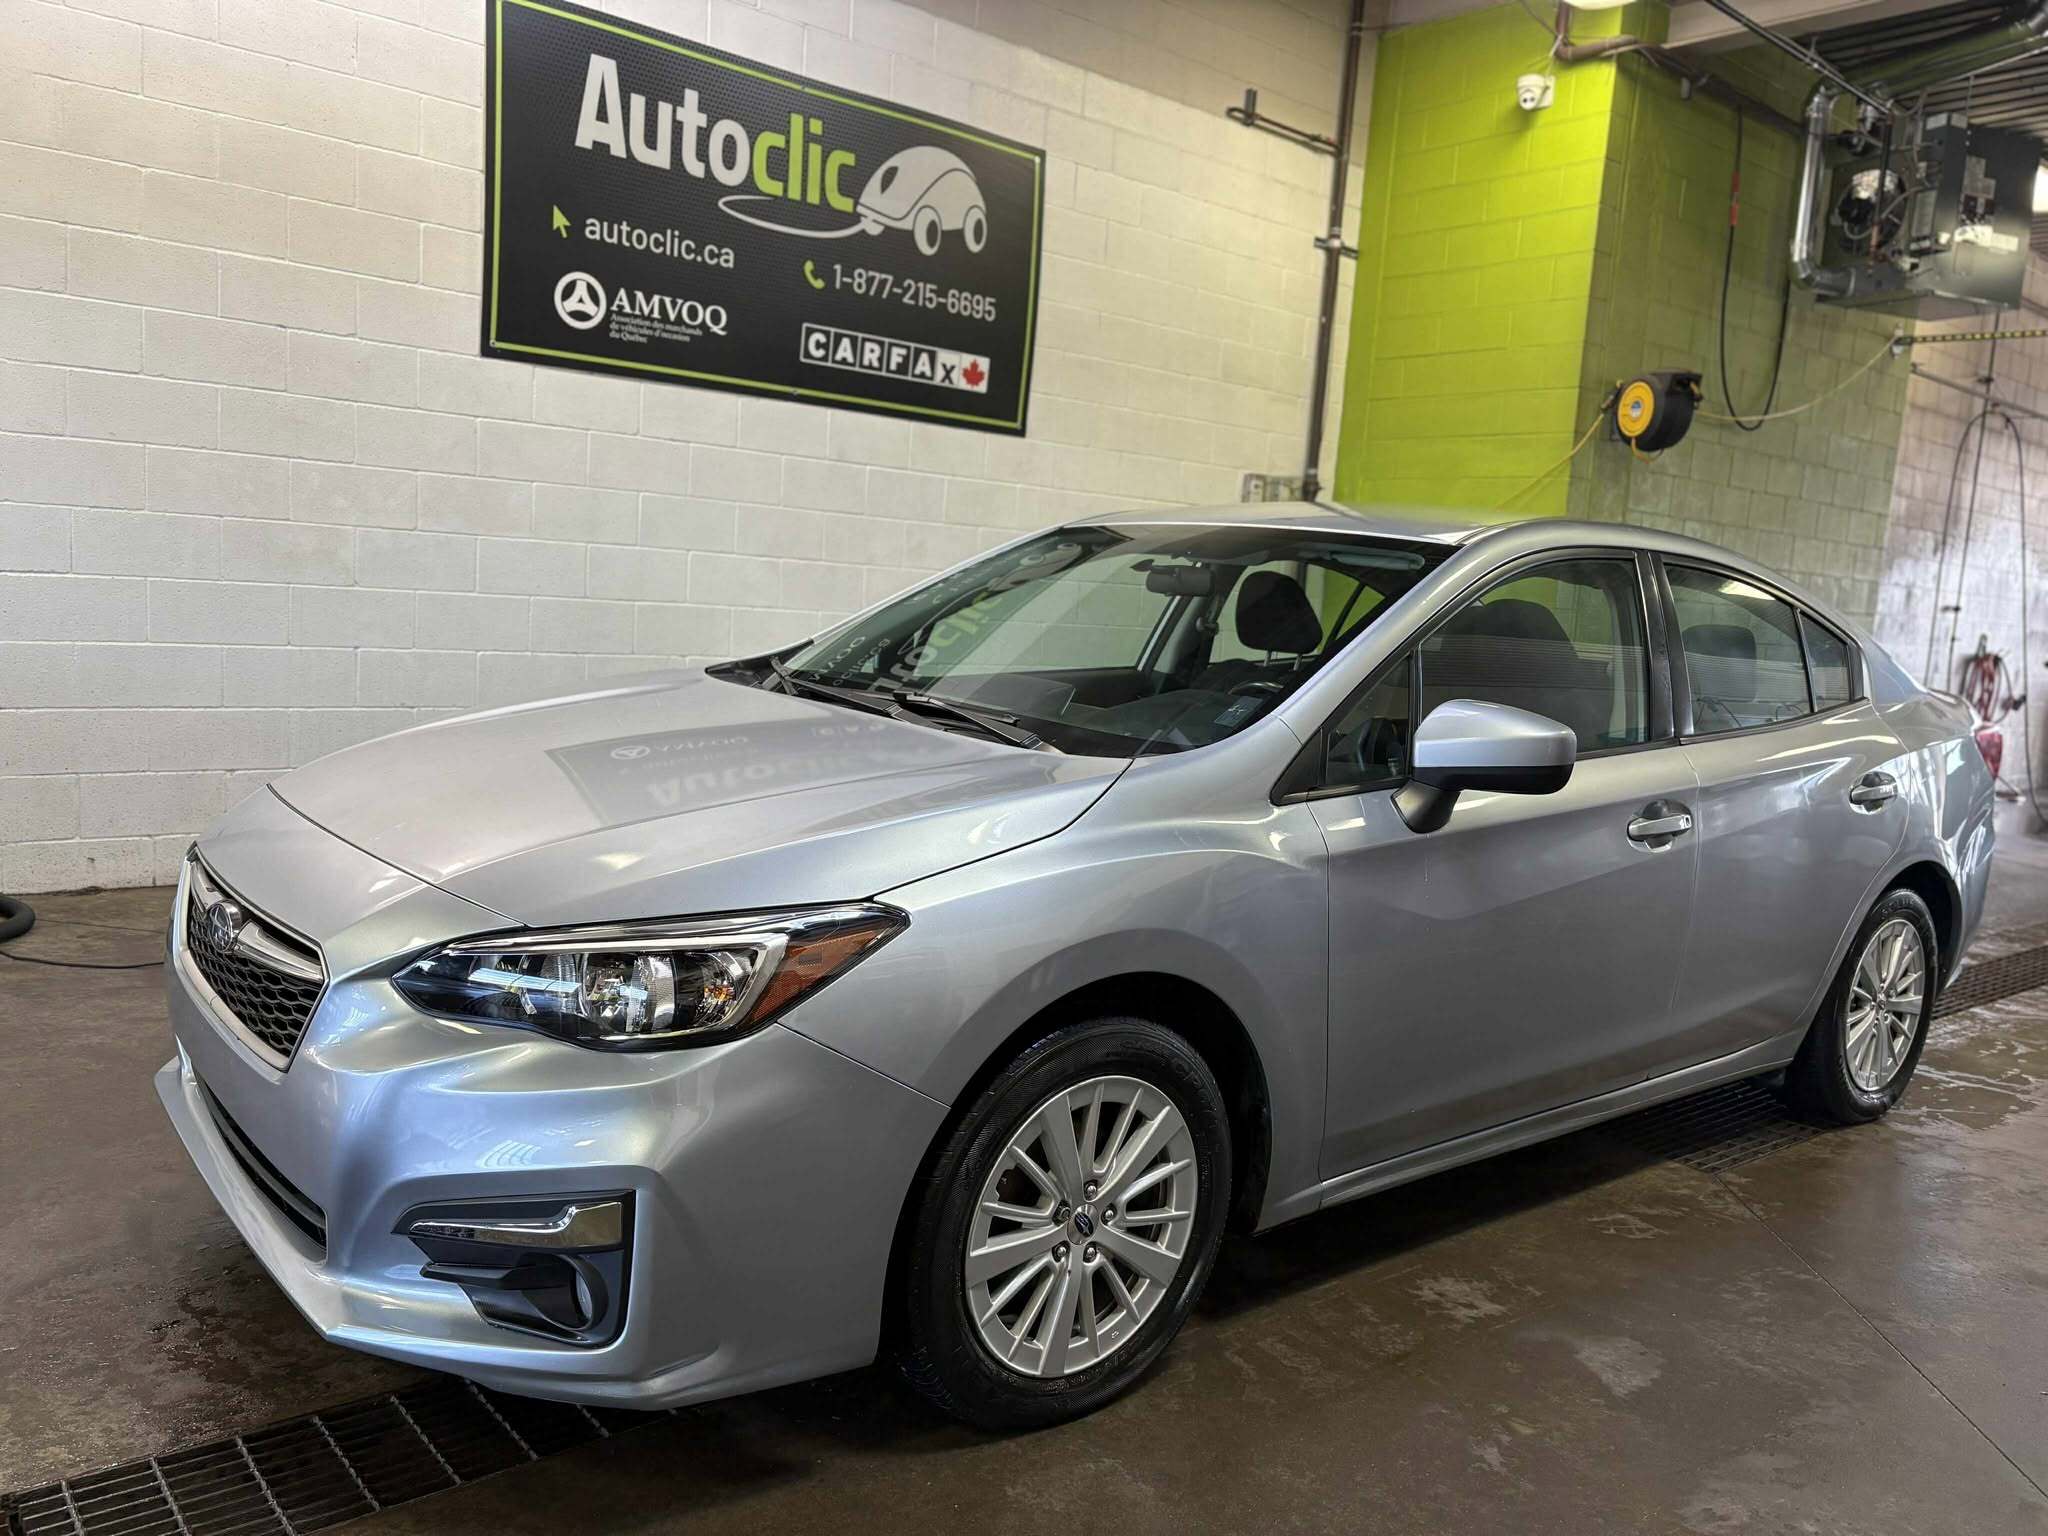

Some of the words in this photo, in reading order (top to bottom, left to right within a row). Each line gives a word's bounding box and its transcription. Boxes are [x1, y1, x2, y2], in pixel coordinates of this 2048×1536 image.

[574, 53, 856, 213] Autoclic
[584, 216, 735, 269] autoclic.ca
[610, 287, 728, 336] AMVOQ
[833, 263, 997, 322] 1-877-215-6695
[807, 331, 957, 386] CARFAX
